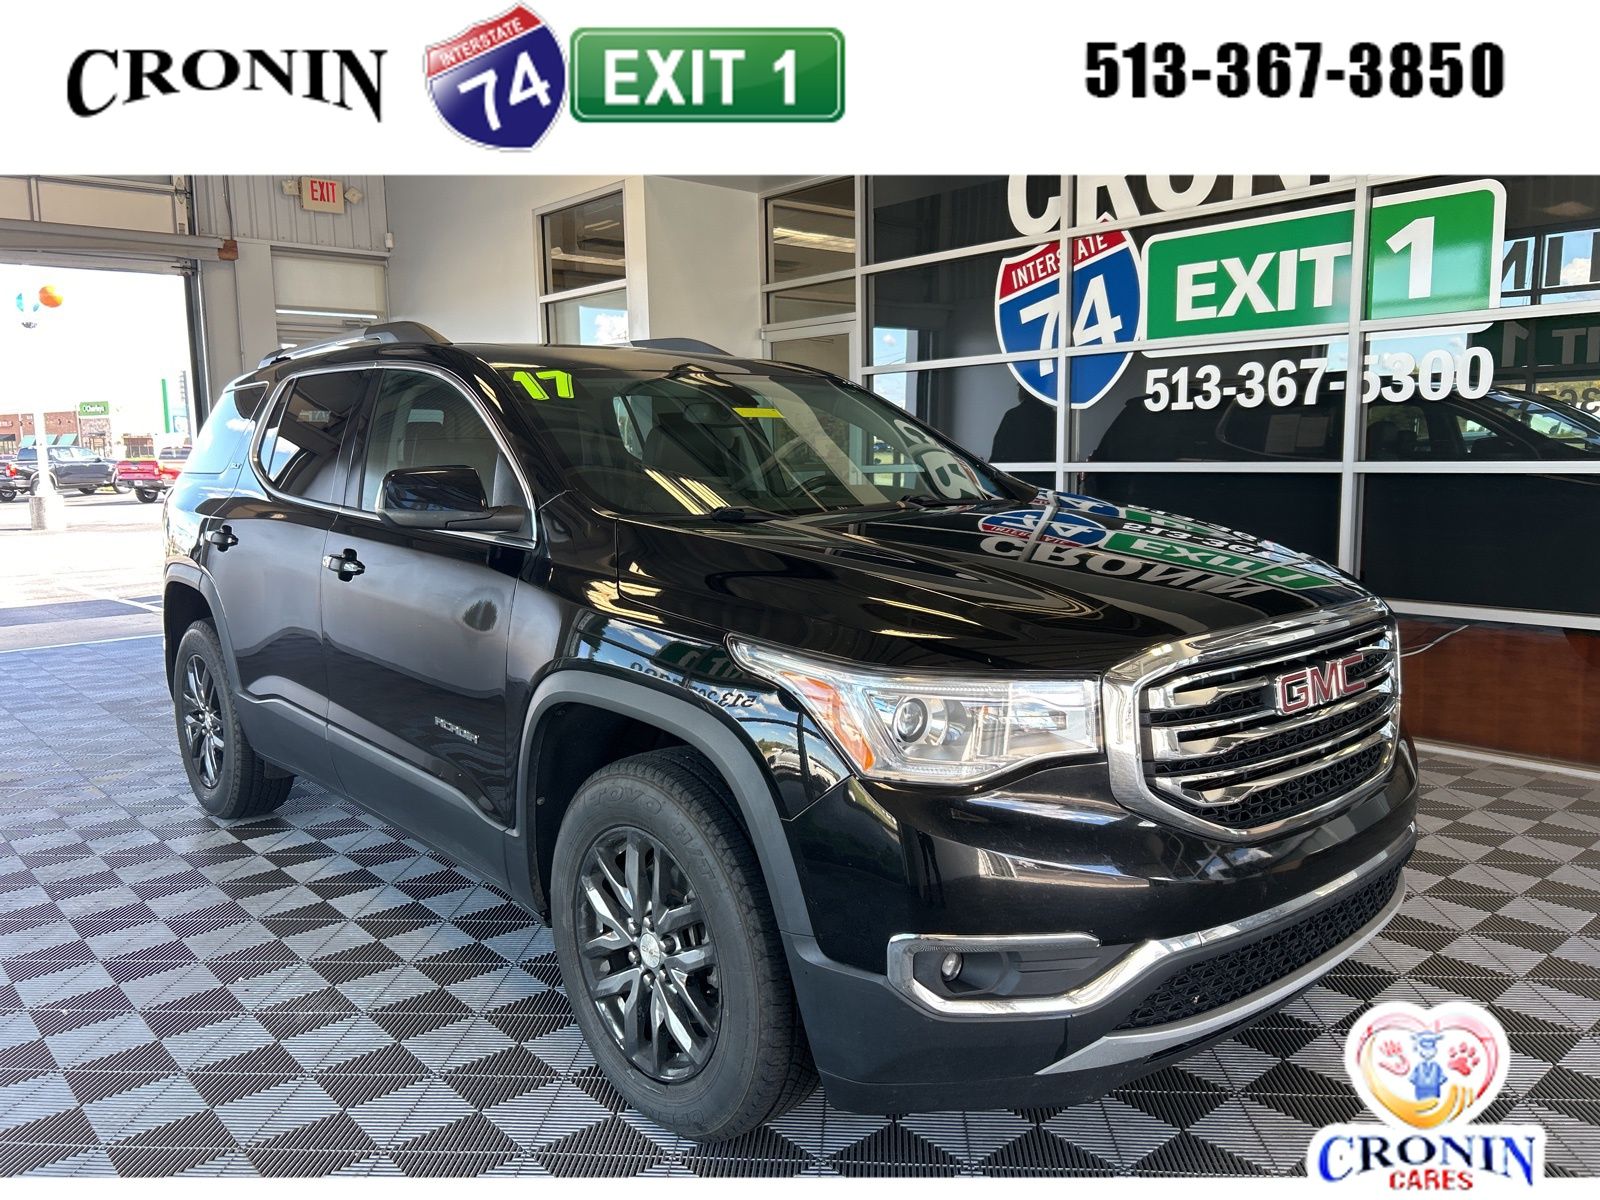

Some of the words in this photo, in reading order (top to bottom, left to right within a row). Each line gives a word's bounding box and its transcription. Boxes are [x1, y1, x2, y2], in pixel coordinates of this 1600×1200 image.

[309, 179, 337, 203] EXIT
[1010, 234, 1108, 290] INTERSATE
[1175, 241, 1352, 322] EXIT
[1385, 216, 1435, 300] 1
[1019, 274, 1123, 377] 74
[512, 370, 575, 401] 17
[1143, 346, 1495, 412] 513-367-5300
[1274, 653, 1367, 715] GMC
